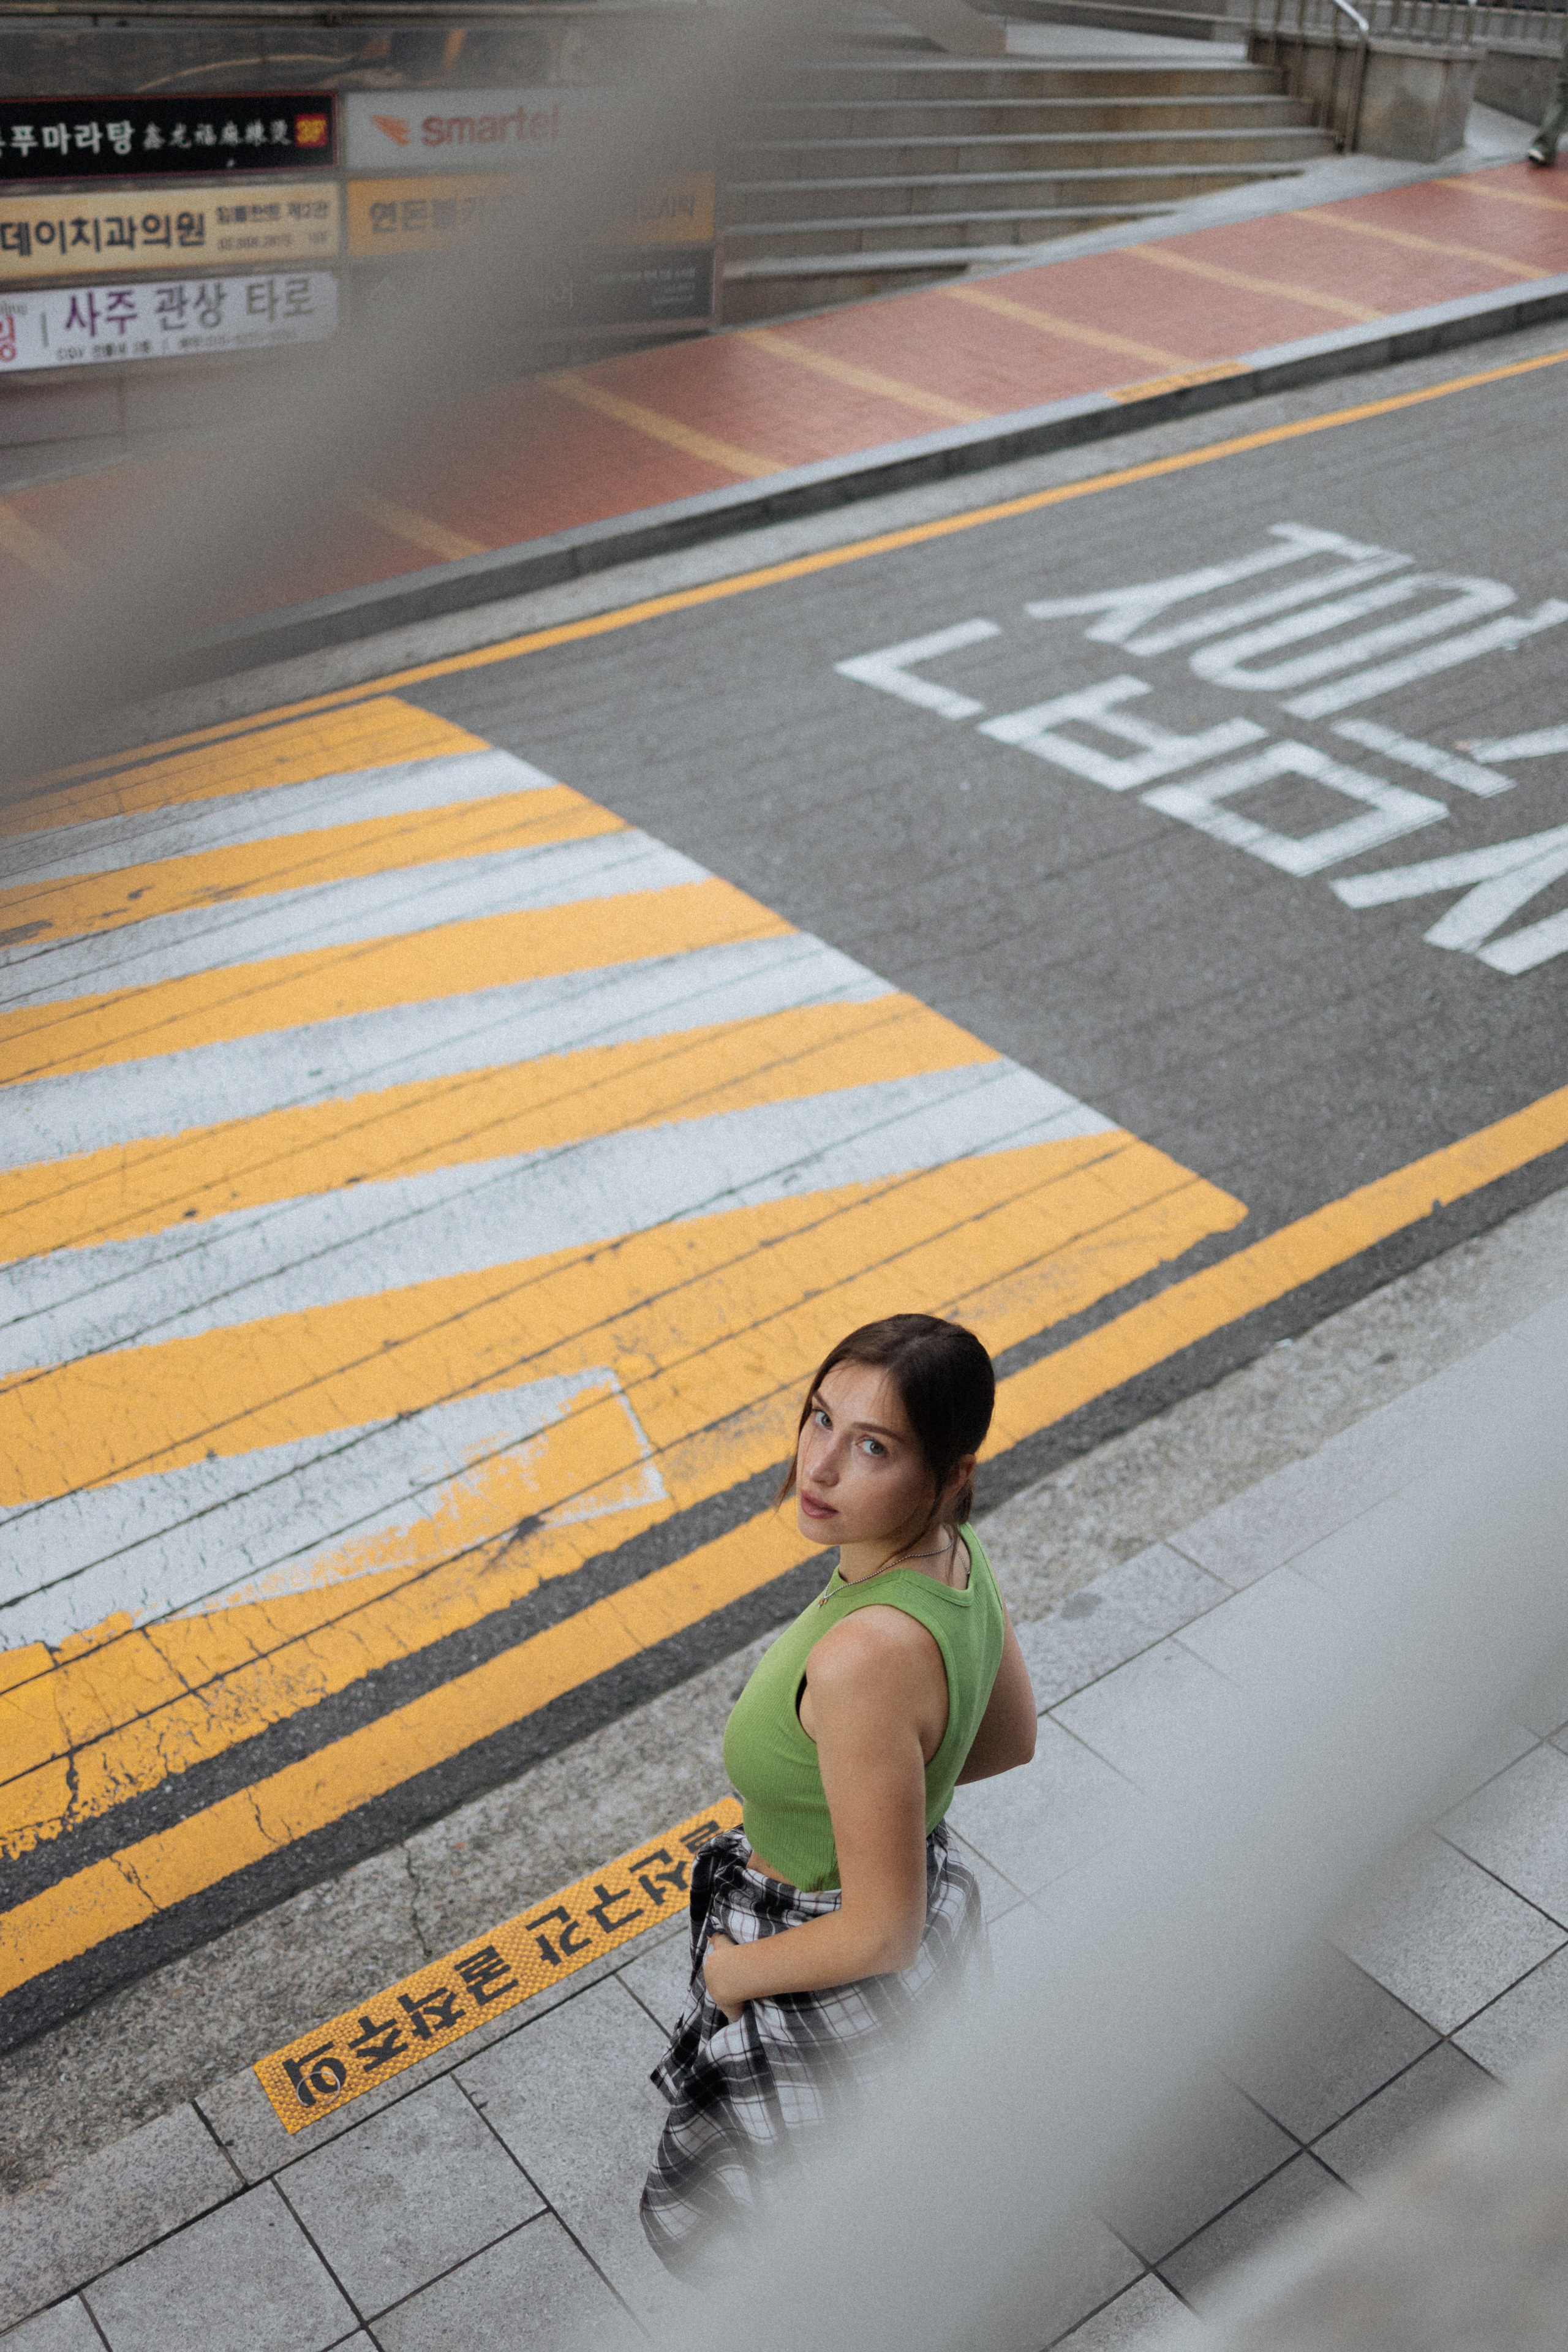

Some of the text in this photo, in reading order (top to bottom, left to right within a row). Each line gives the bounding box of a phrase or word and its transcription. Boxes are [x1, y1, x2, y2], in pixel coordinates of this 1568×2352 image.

[0, 121, 135, 157] 푸마라탕
[421, 102, 560, 146] smartel
[0, 211, 205, 255] 데이치과의원
[64, 290, 138, 337] 사주
[154, 283, 227, 331] 관상
[246, 277, 315, 323] 타로
[281, 1944, 519, 2108] 굴착주의
